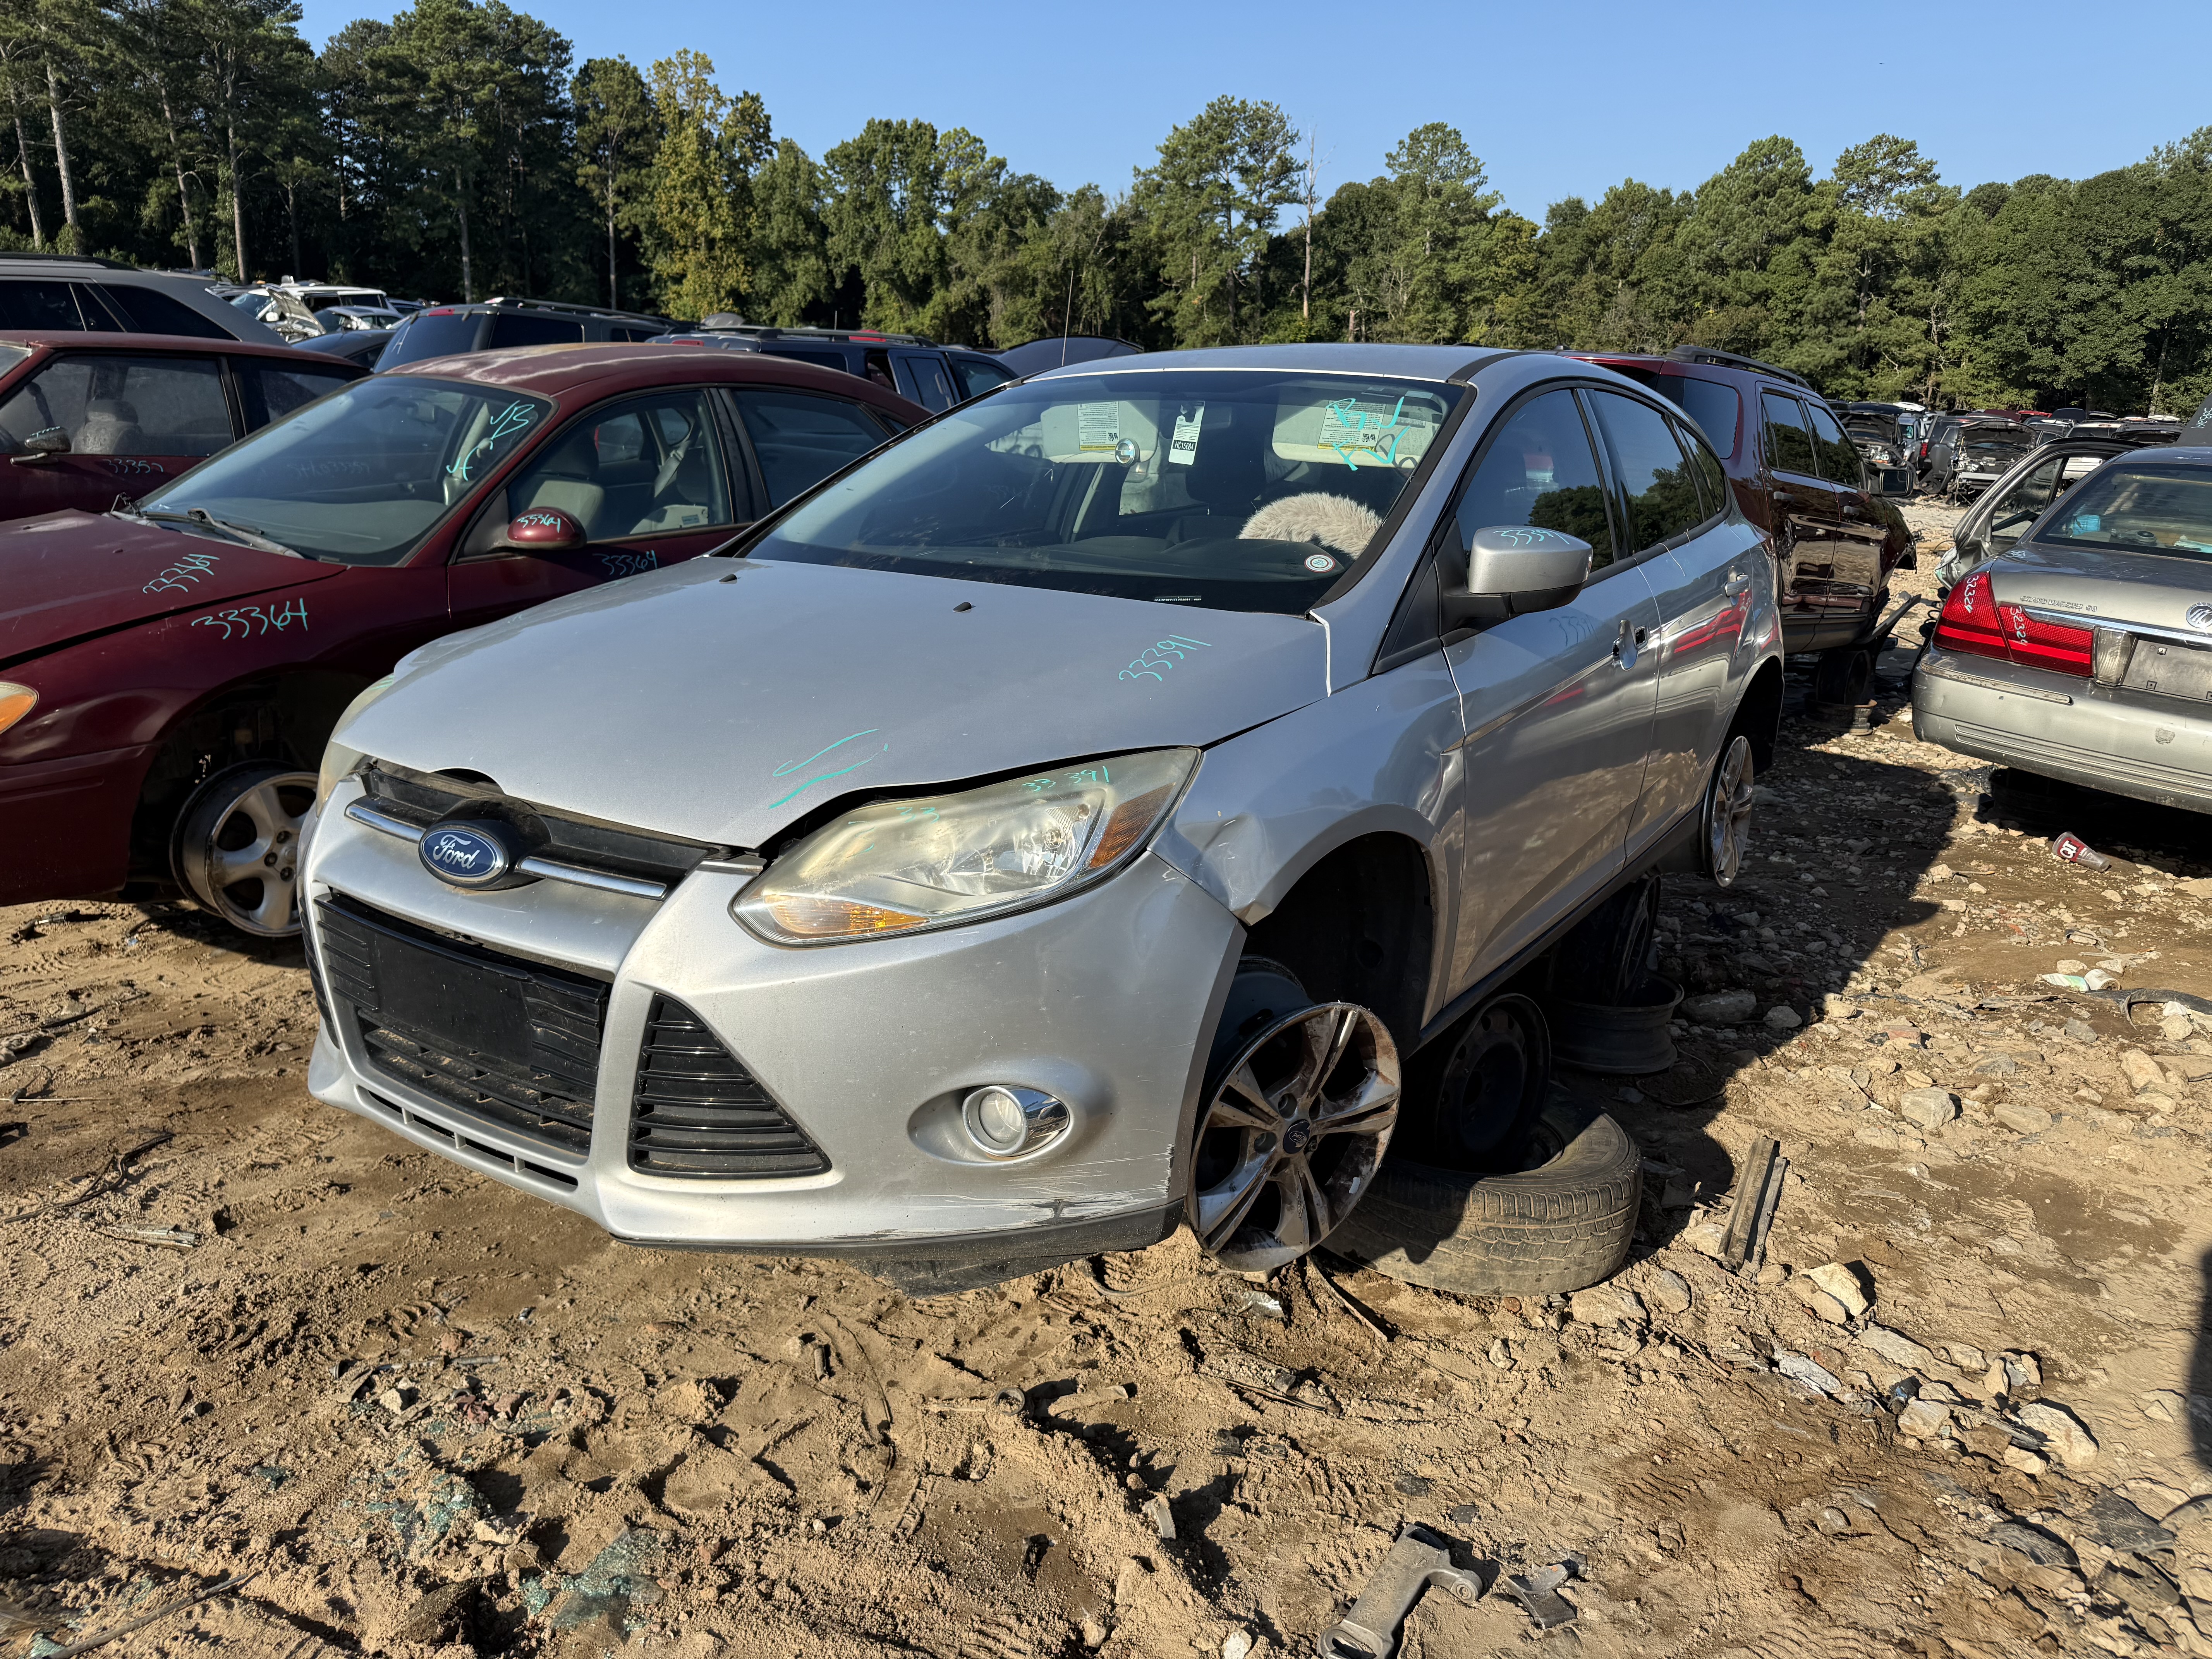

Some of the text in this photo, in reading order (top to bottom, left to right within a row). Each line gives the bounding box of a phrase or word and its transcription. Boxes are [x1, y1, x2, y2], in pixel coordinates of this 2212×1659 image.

[517, 513, 561, 533] 33364
[1493, 529, 1570, 547] 33391
[143, 553, 220, 594] 33364
[592, 550, 659, 575] 33364
[191, 598, 308, 640] 33364
[1118, 634, 1212, 681] 33391
[433, 834, 480, 869] Ford
[2059, 840, 2077, 859] QT
